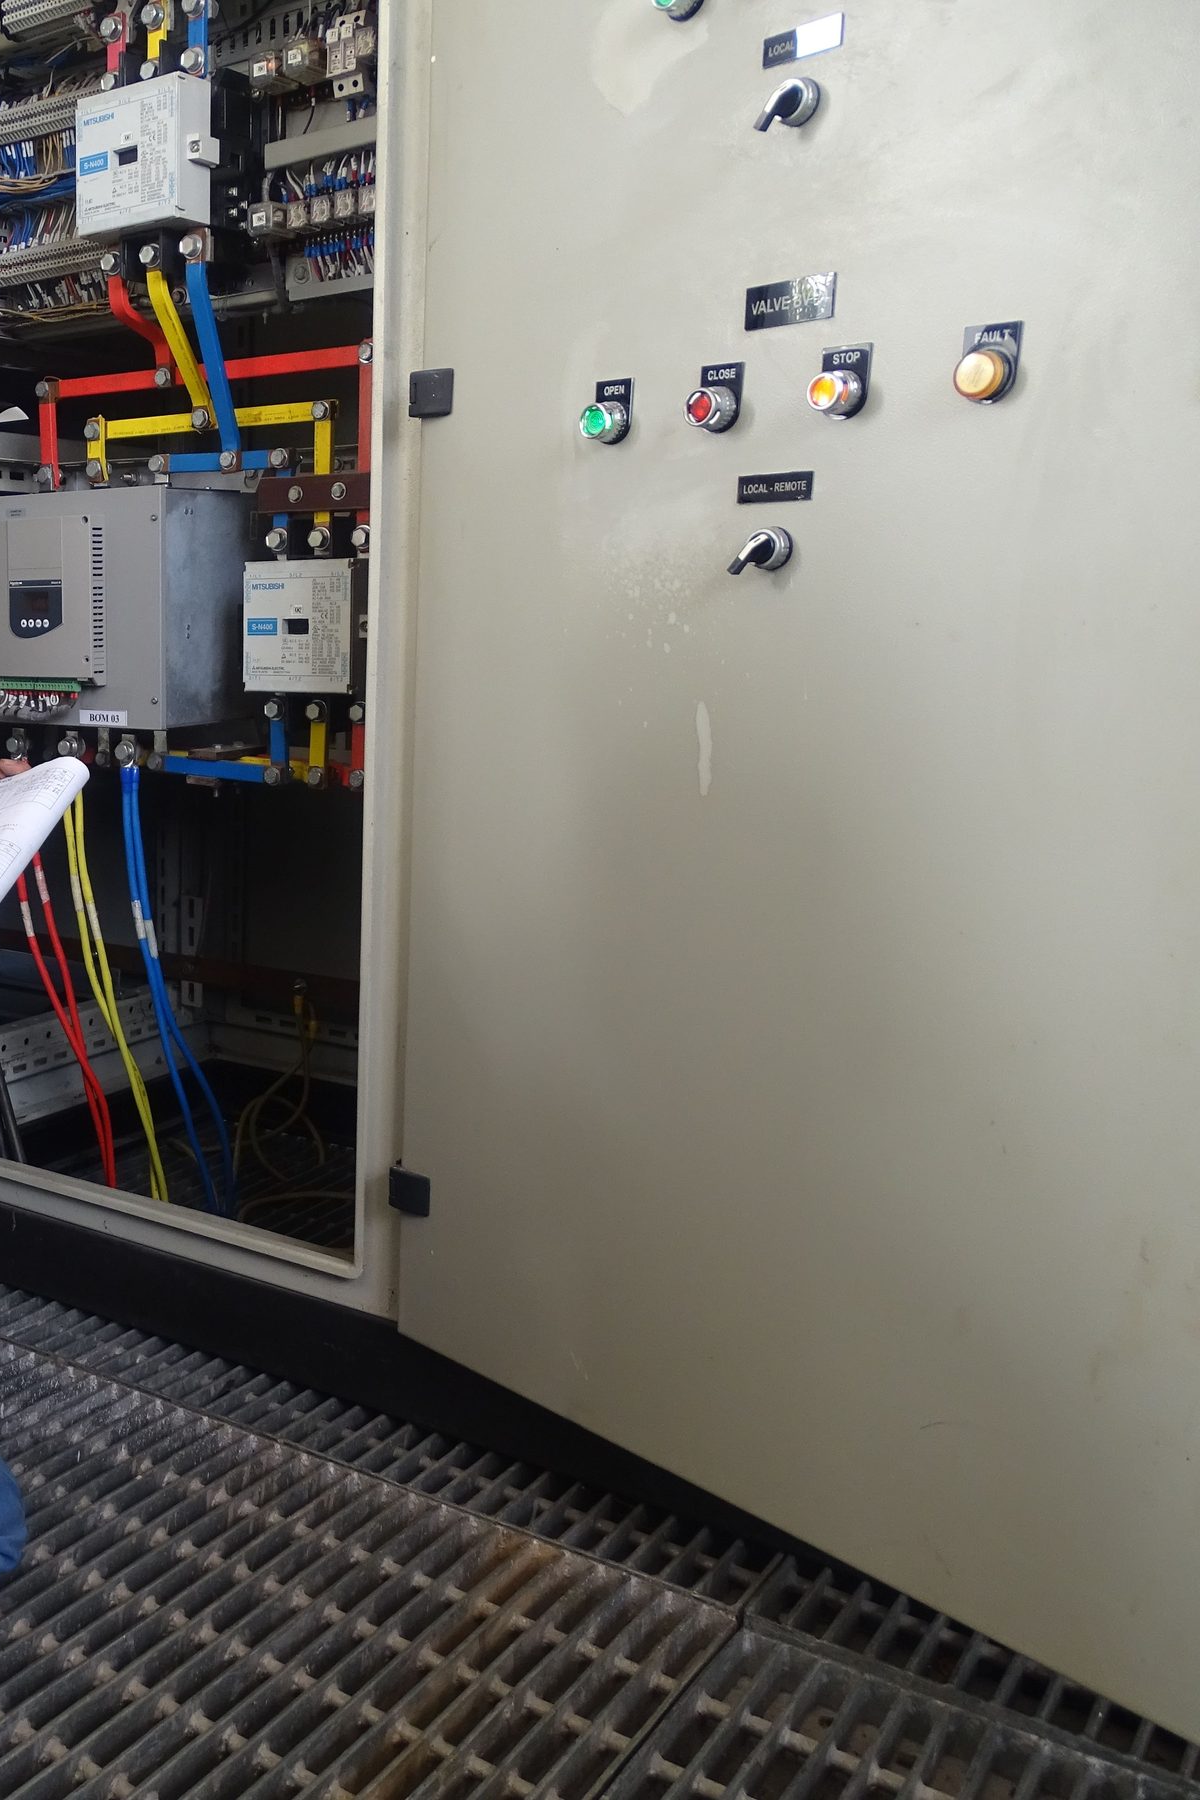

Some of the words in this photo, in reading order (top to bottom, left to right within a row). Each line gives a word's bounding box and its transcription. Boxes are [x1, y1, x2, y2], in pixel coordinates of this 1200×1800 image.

[768, 40, 795, 58] LOCAL
[83, 111, 115, 126] MITSUBISHI
[83, 158, 104, 170] S-N400
[751, 296, 790, 316] VALVE
[974, 328, 1011, 344] FAULT
[832, 351, 861, 365] STOP
[707, 368, 737, 381] CLOSE
[603, 384, 625, 397] OPEN
[743, 483, 768, 495] LOCAL
[773, 480, 807, 493] REMOTE
[251, 582, 285, 591] MITSUBISHI
[251, 623, 274, 631] S-N400
[110, 714, 120, 724] 03
